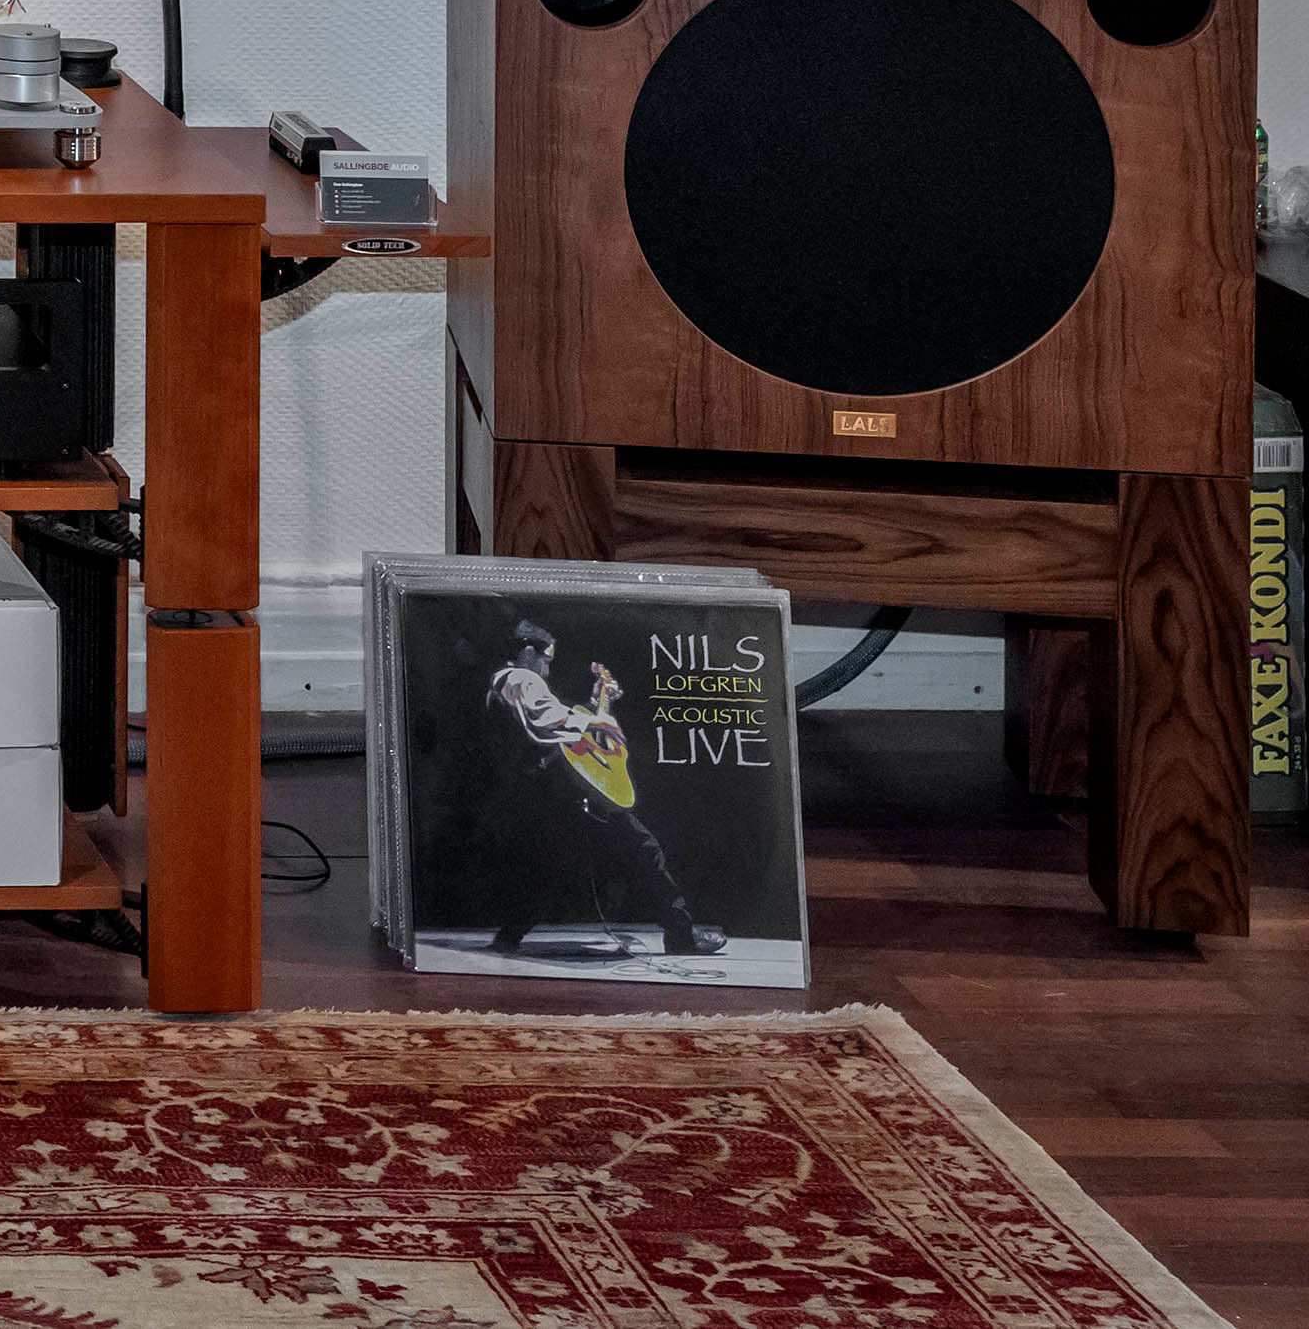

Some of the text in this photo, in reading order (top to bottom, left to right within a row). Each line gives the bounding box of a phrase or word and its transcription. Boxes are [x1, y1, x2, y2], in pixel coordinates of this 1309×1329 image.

[333, 162, 420, 172] SALLINGBOE AUDIO
[357, 241, 381, 249] SOLID
[1249, 488, 1287, 643] KONDI
[649, 633, 765, 673] NILS
[655, 674, 761, 693] LOFGREN
[652, 706, 767, 726] ACOUSTIC
[1252, 657, 1290, 775] FAXE
[656, 726, 771, 767] LIVE
